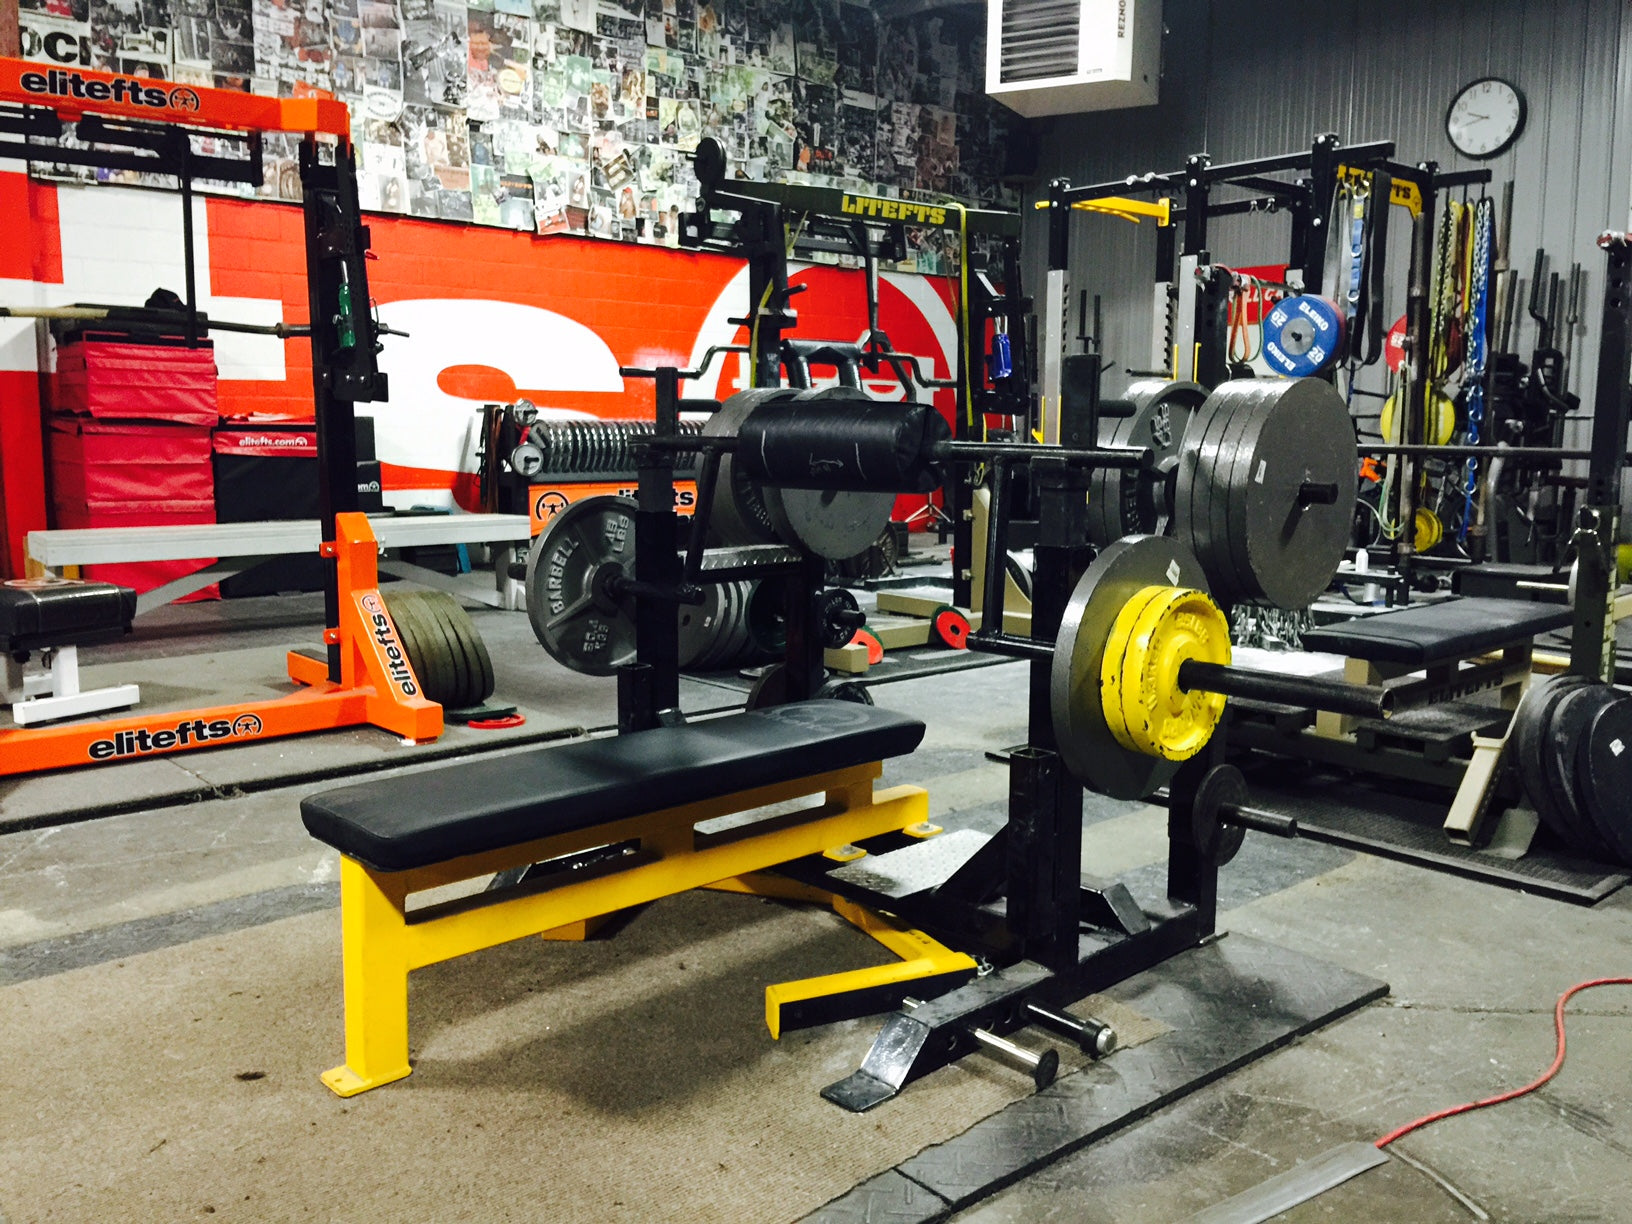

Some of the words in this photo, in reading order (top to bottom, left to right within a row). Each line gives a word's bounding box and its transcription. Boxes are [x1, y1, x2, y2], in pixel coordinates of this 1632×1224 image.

[20, 69, 169, 109] elitefts
[1271, 310, 1288, 328] 20
[1298, 301, 1330, 332] ELEIKO
[1266, 341, 1297, 371] ELEIKO
[1307, 345, 1325, 363] 20
[239, 436, 296, 447] elitefts.com
[604, 518, 618, 542] 45
[613, 514, 630, 553] LBS
[548, 536, 580, 616] BARBELL
[372, 613, 417, 697] elitefts
[88, 719, 232, 760] elitefts
